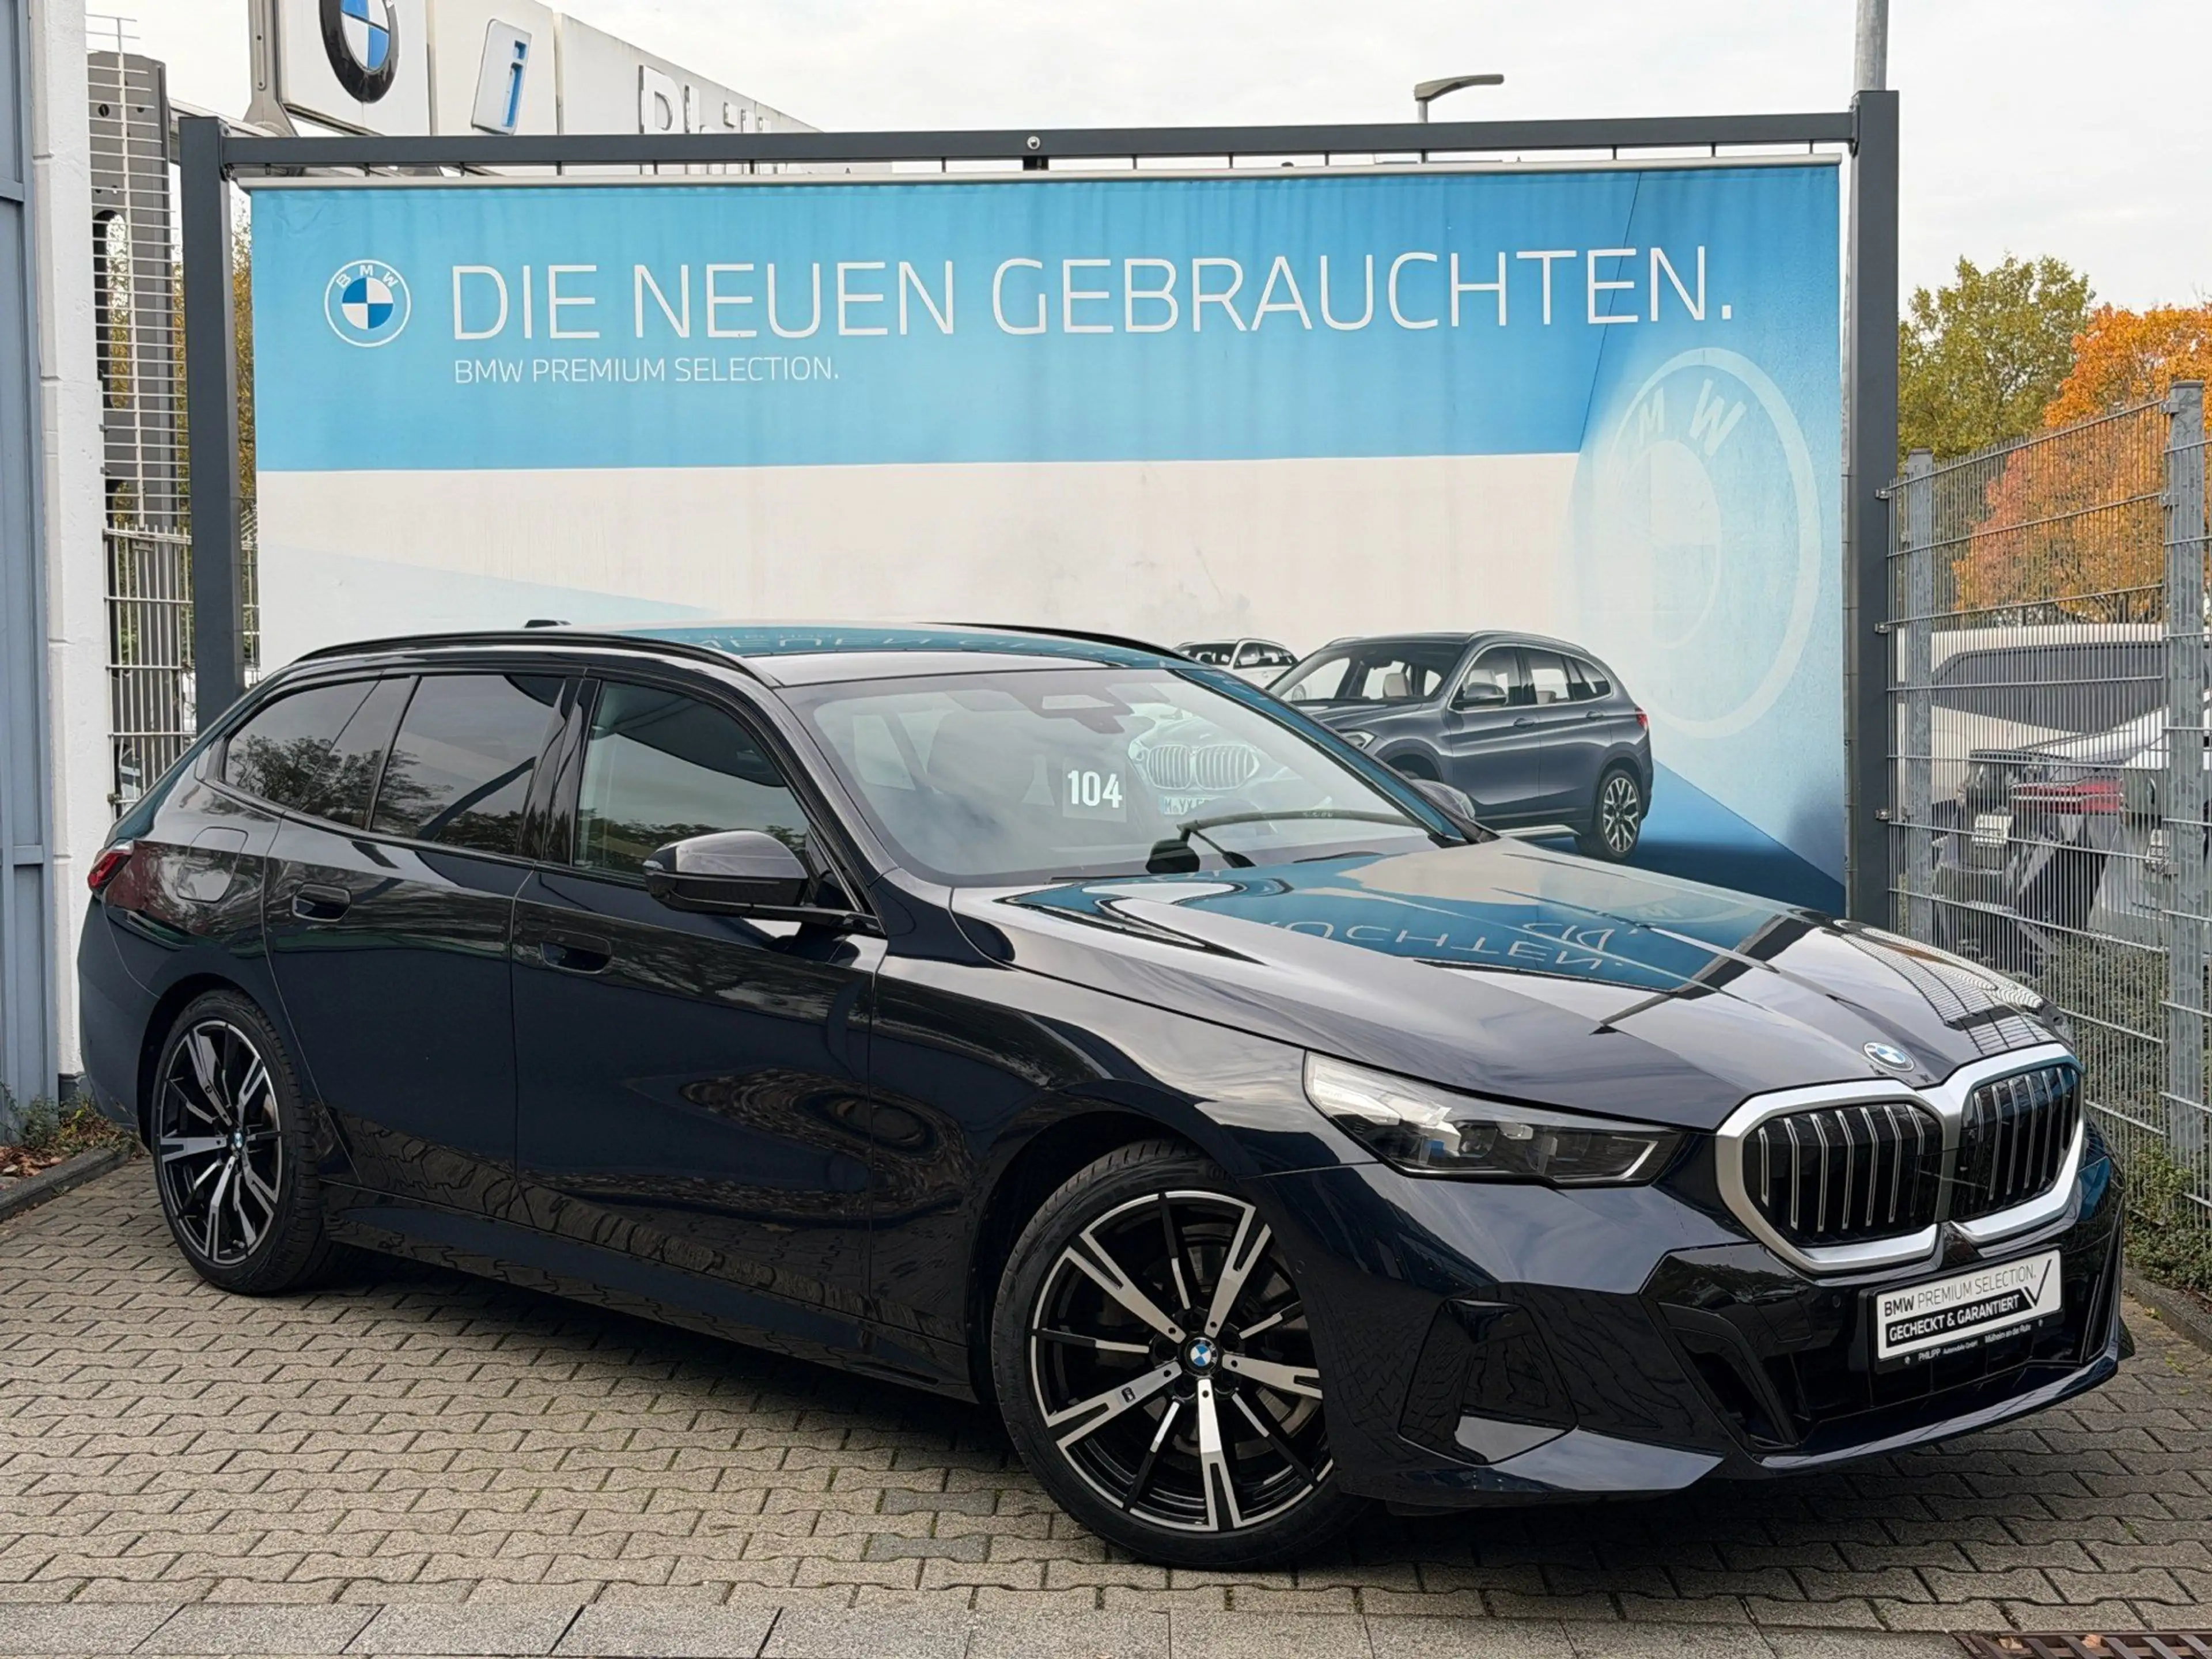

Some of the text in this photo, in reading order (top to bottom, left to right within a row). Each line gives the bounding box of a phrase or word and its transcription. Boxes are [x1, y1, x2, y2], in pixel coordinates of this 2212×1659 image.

[336, 264, 398, 289] BMW
[452, 245, 1732, 340] DIE NEUEN GEBRAUCHTEN.
[454, 356, 839, 384] BMW PREMIUM SELECTION.
[1067, 770, 1123, 808] 104
[1884, 1264, 2036, 1317] BMW PREMIUM SELECTION.
[1889, 1294, 2020, 1342] GECHECKT & GARANTIERT
